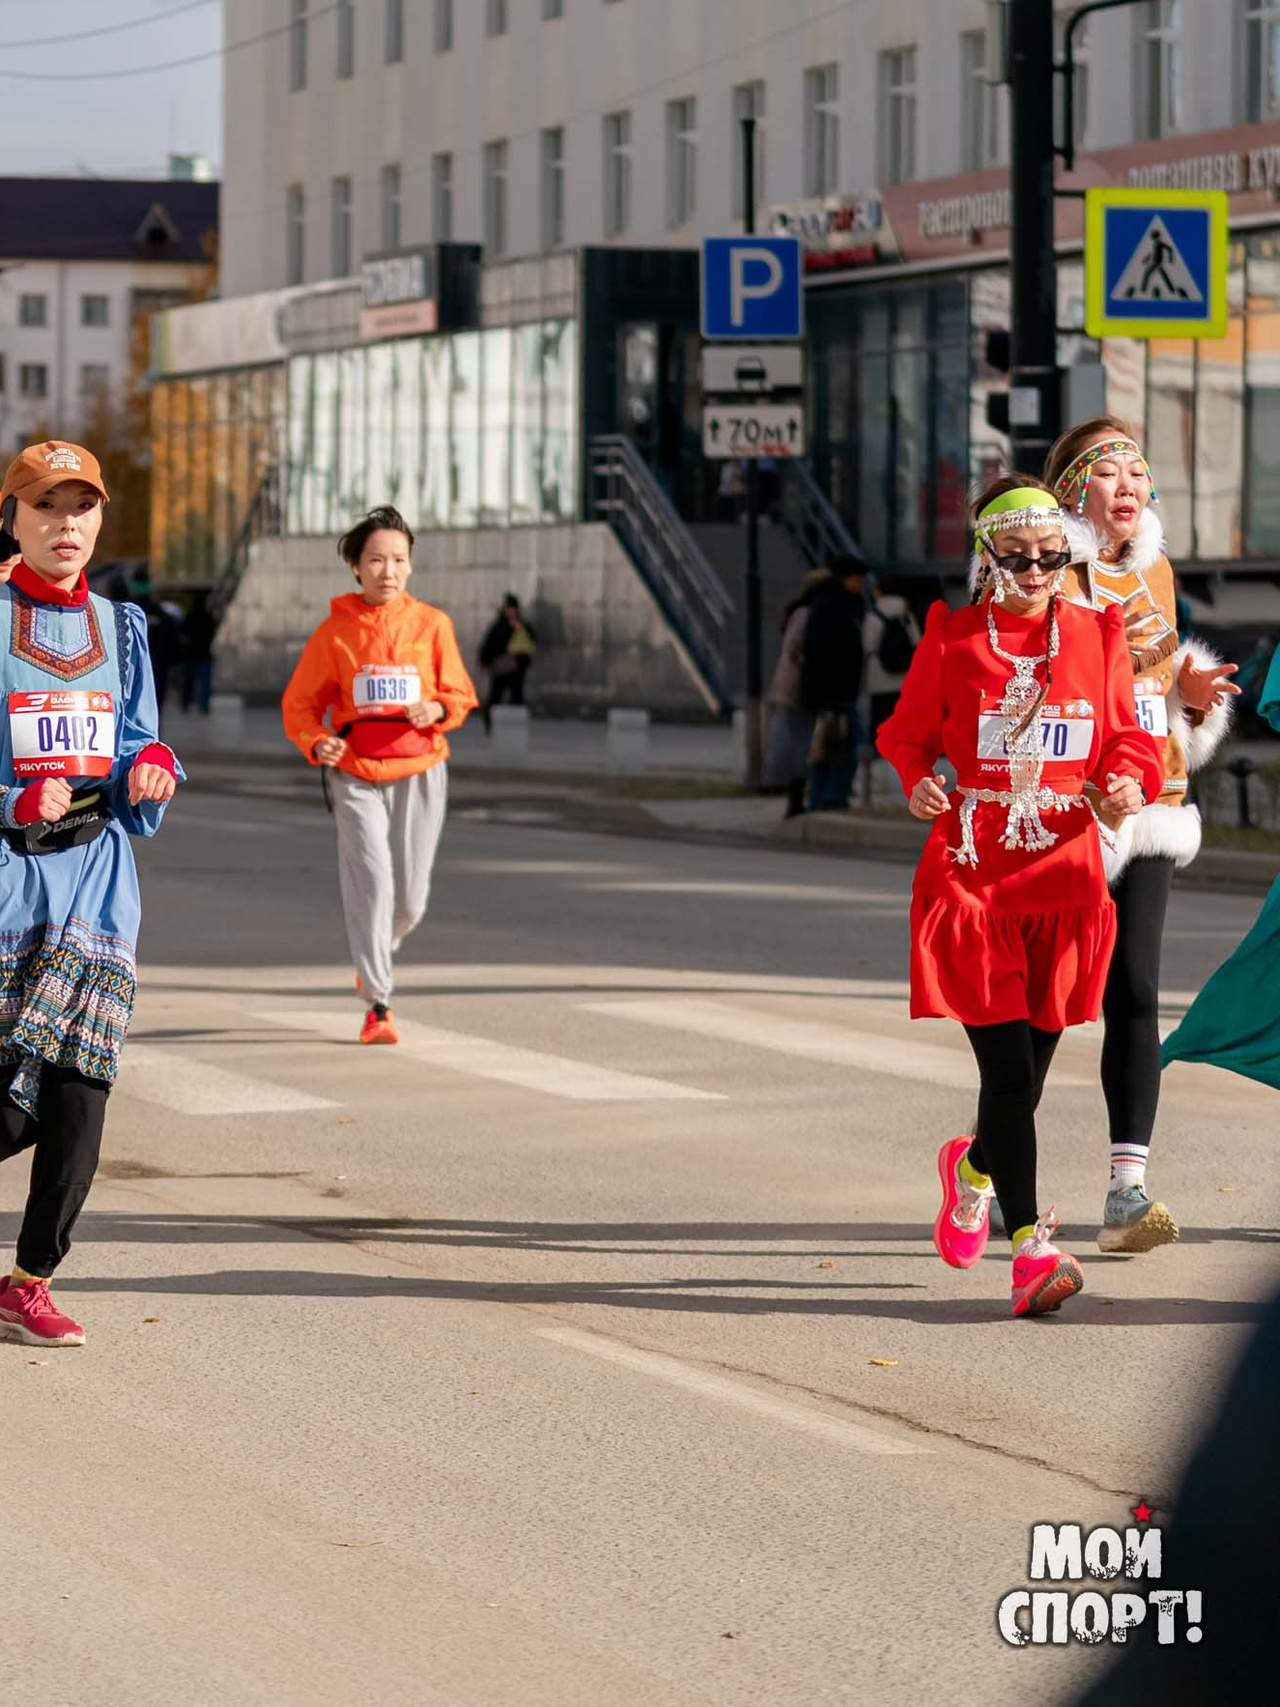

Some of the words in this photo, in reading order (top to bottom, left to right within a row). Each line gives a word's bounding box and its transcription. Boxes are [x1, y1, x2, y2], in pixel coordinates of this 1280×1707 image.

[730, 247, 783, 327] P
[366, 678, 407, 700] 0636
[38, 715, 99, 752] 0402
[19, 761, 65, 771] ЯКУТСК
[980, 763, 1012, 772] ЯКУТ
[53, 811, 99, 833] DEMIX
